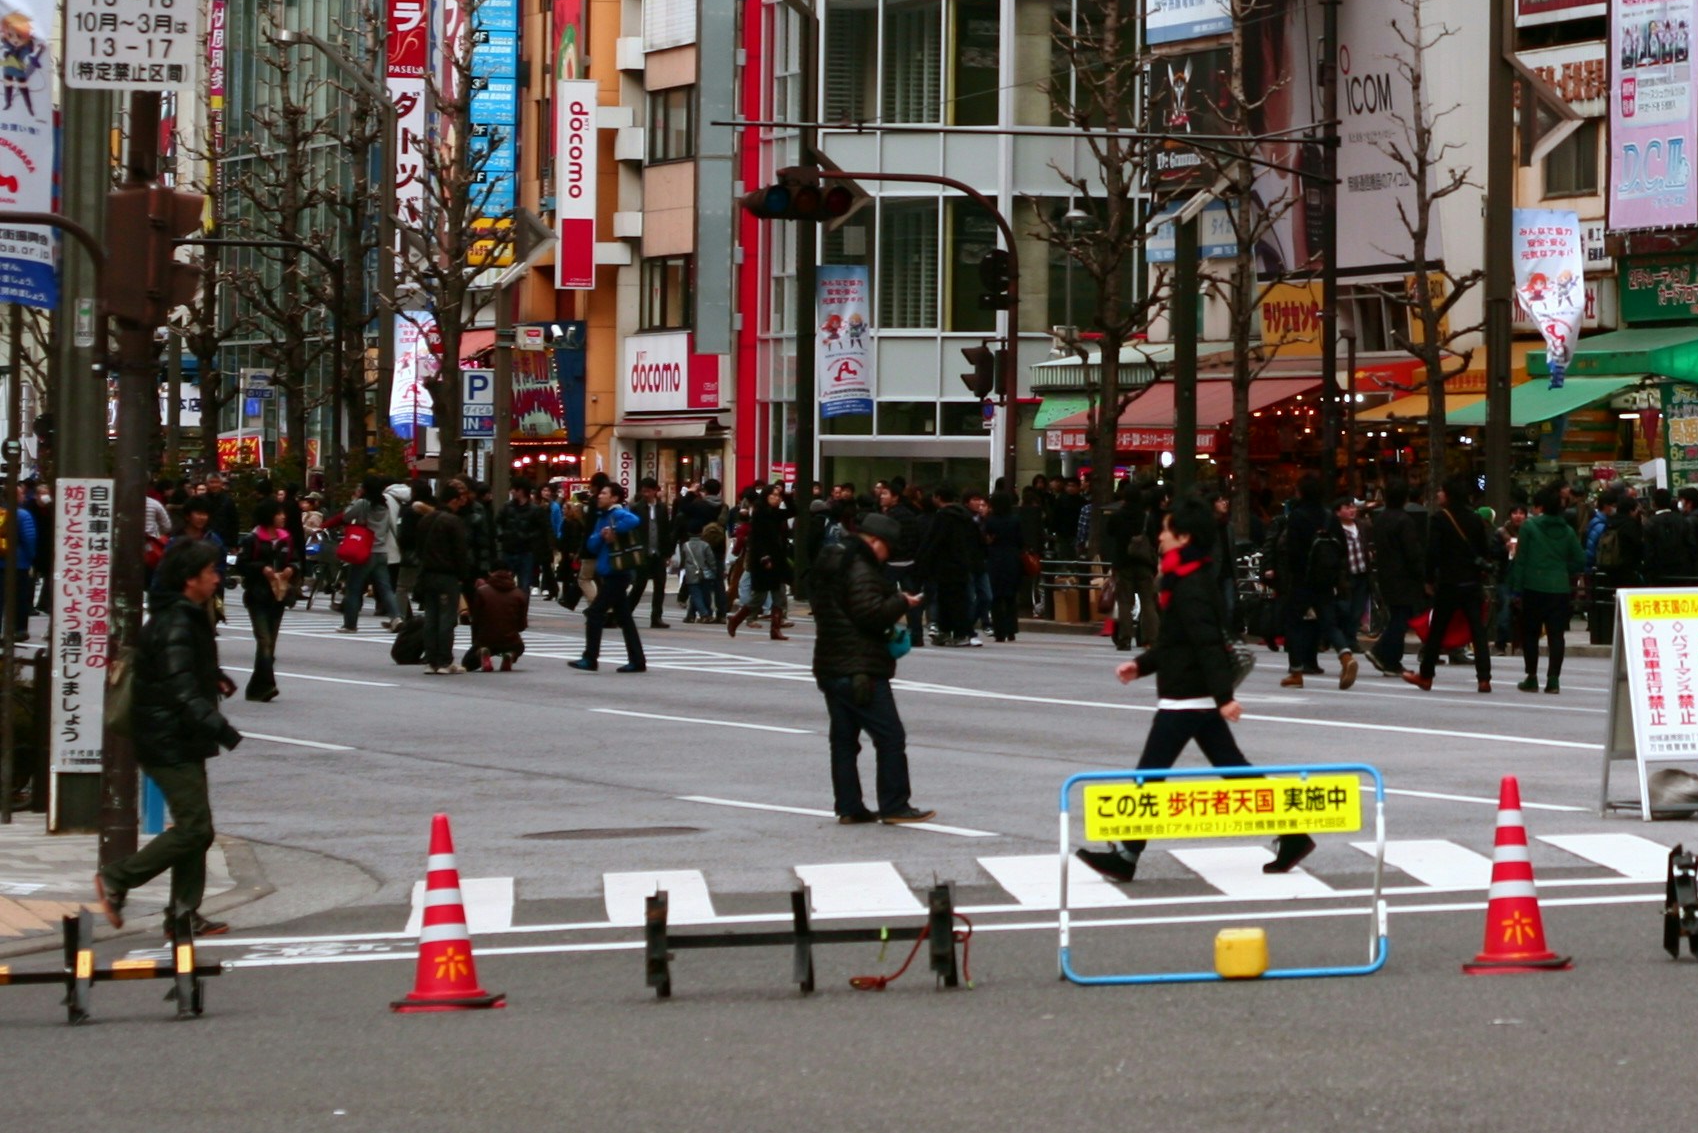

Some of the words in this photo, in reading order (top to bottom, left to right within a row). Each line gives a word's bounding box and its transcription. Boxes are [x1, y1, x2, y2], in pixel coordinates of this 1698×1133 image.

[1345, 73, 1392, 115] ICOM
[569, 100, 588, 199] docomo
[469, 375, 488, 400] P
[631, 351, 680, 393] docomo
[464, 418, 479, 430] IN
[85, 486, 110, 668] 自転車は歩行者の通行の
[61, 485, 86, 743] 妨げとならないよう通行しましょう
[1642, 637, 1667, 726] 自転車走行禁止
[1672, 635, 1697, 726] パフォーマンス禁止
[1097, 793, 1159, 817] この先
[1167, 788, 1275, 816] 歩行者天国
[1283, 785, 1347, 812] 実施中
